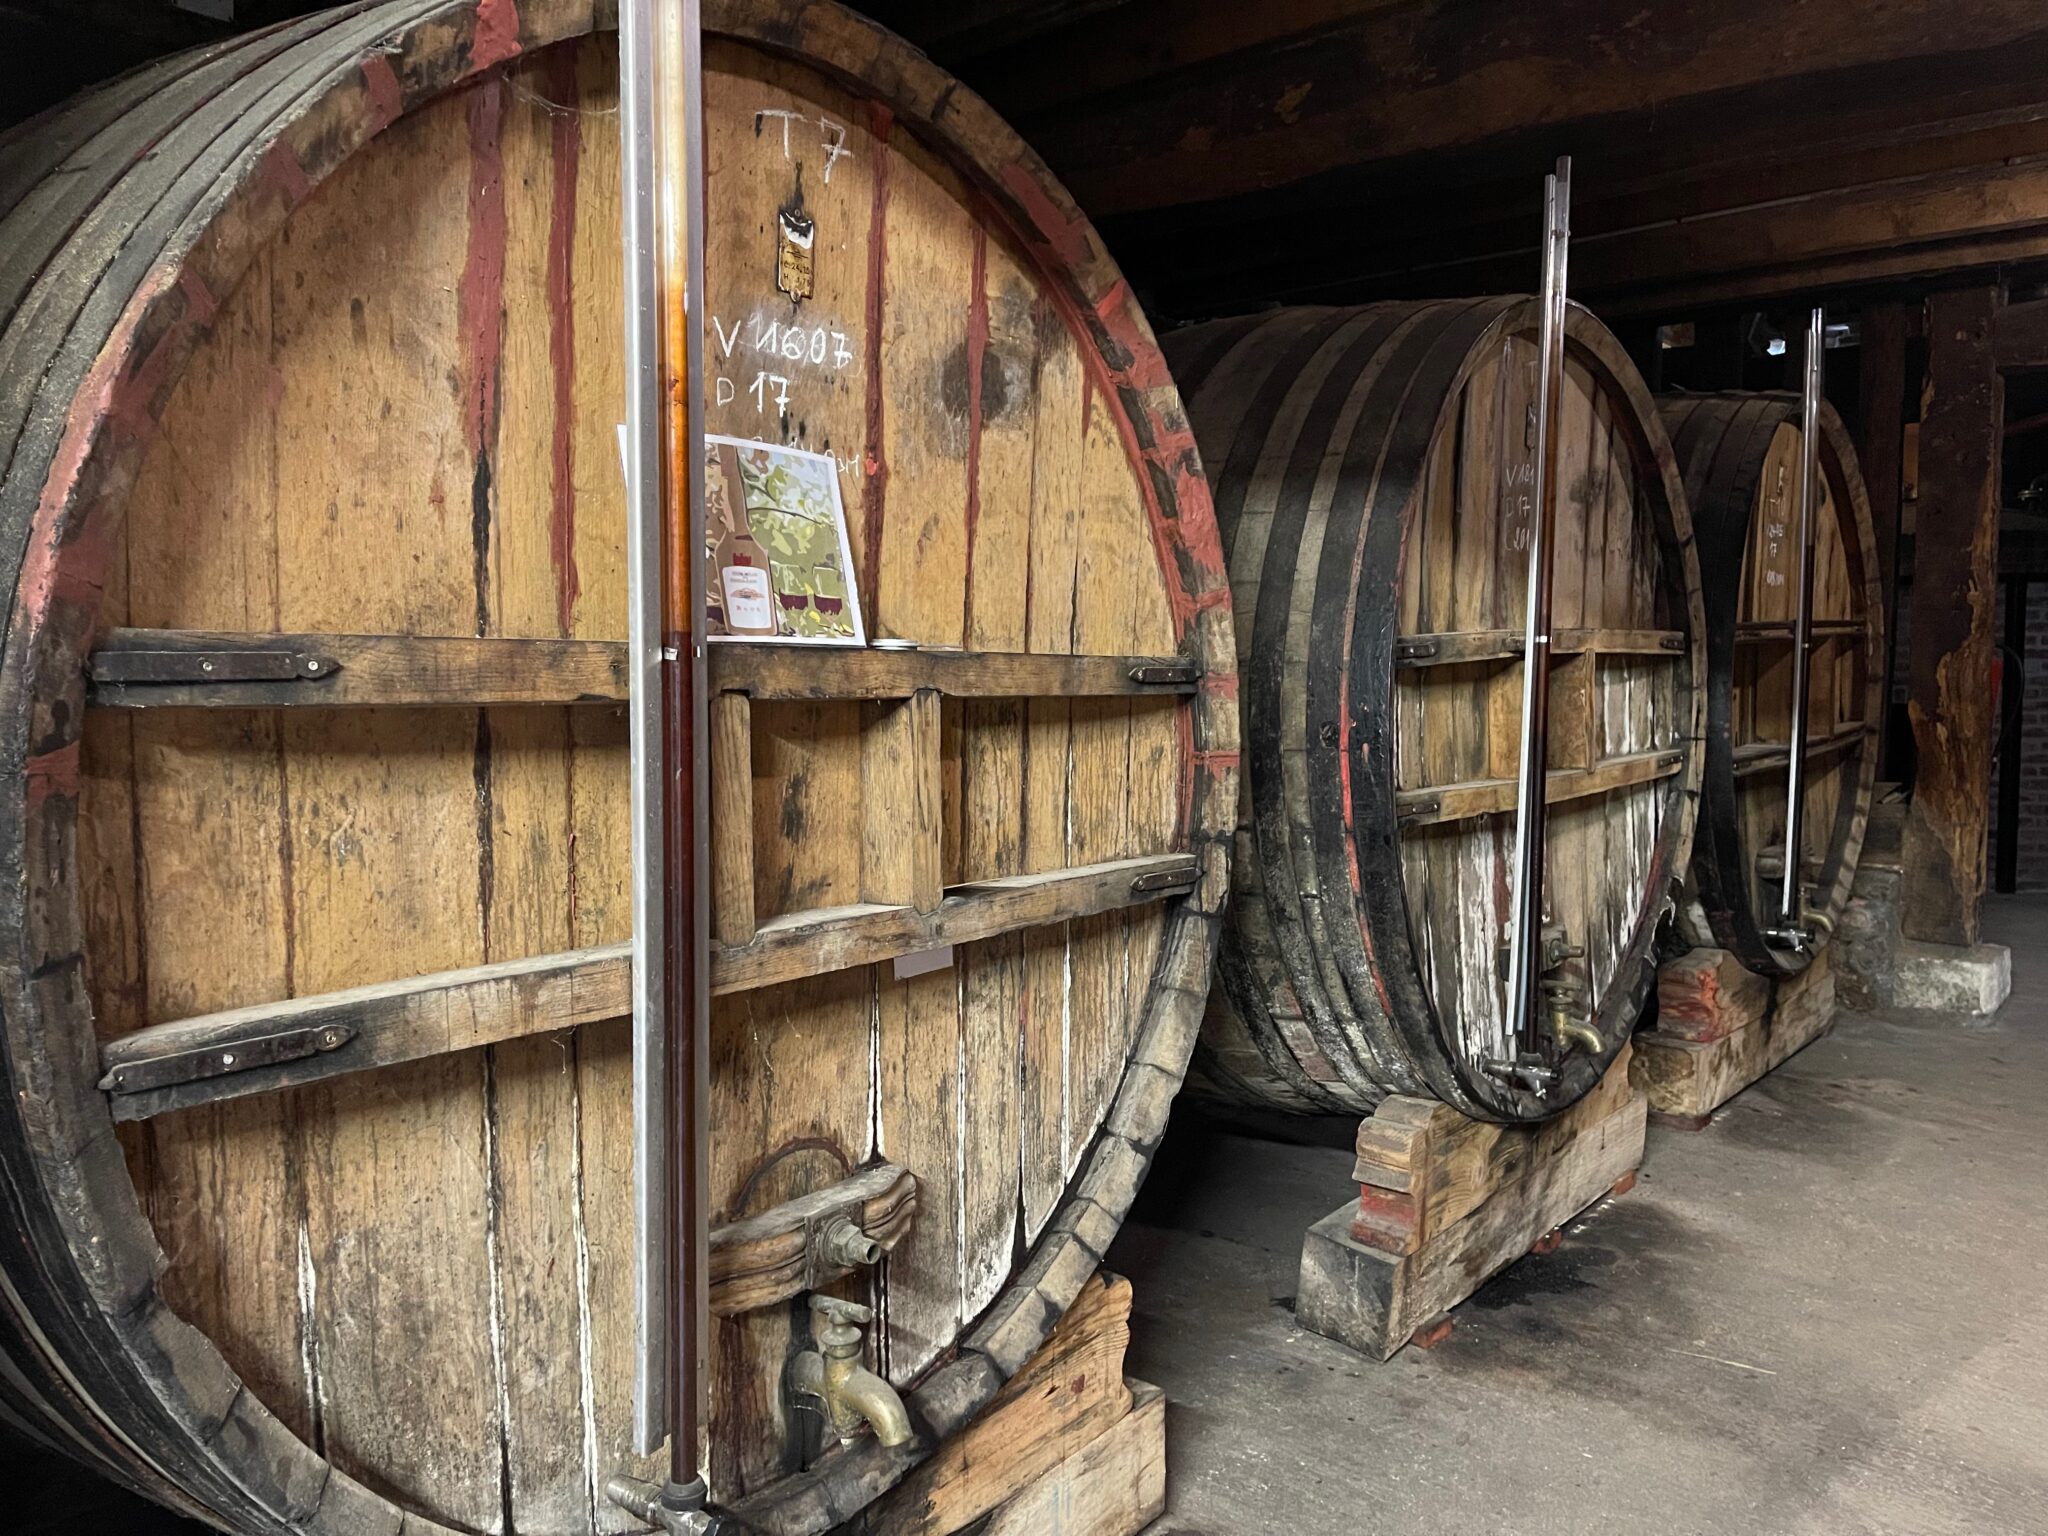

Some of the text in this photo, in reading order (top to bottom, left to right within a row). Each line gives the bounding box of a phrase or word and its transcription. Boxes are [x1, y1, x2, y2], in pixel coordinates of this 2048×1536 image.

[755, 109, 853, 184] T 7
[713, 315, 741, 358] V
[716, 371, 791, 418] D 17
[1506, 464, 1518, 487] V
[1517, 495, 1531, 518] 17
